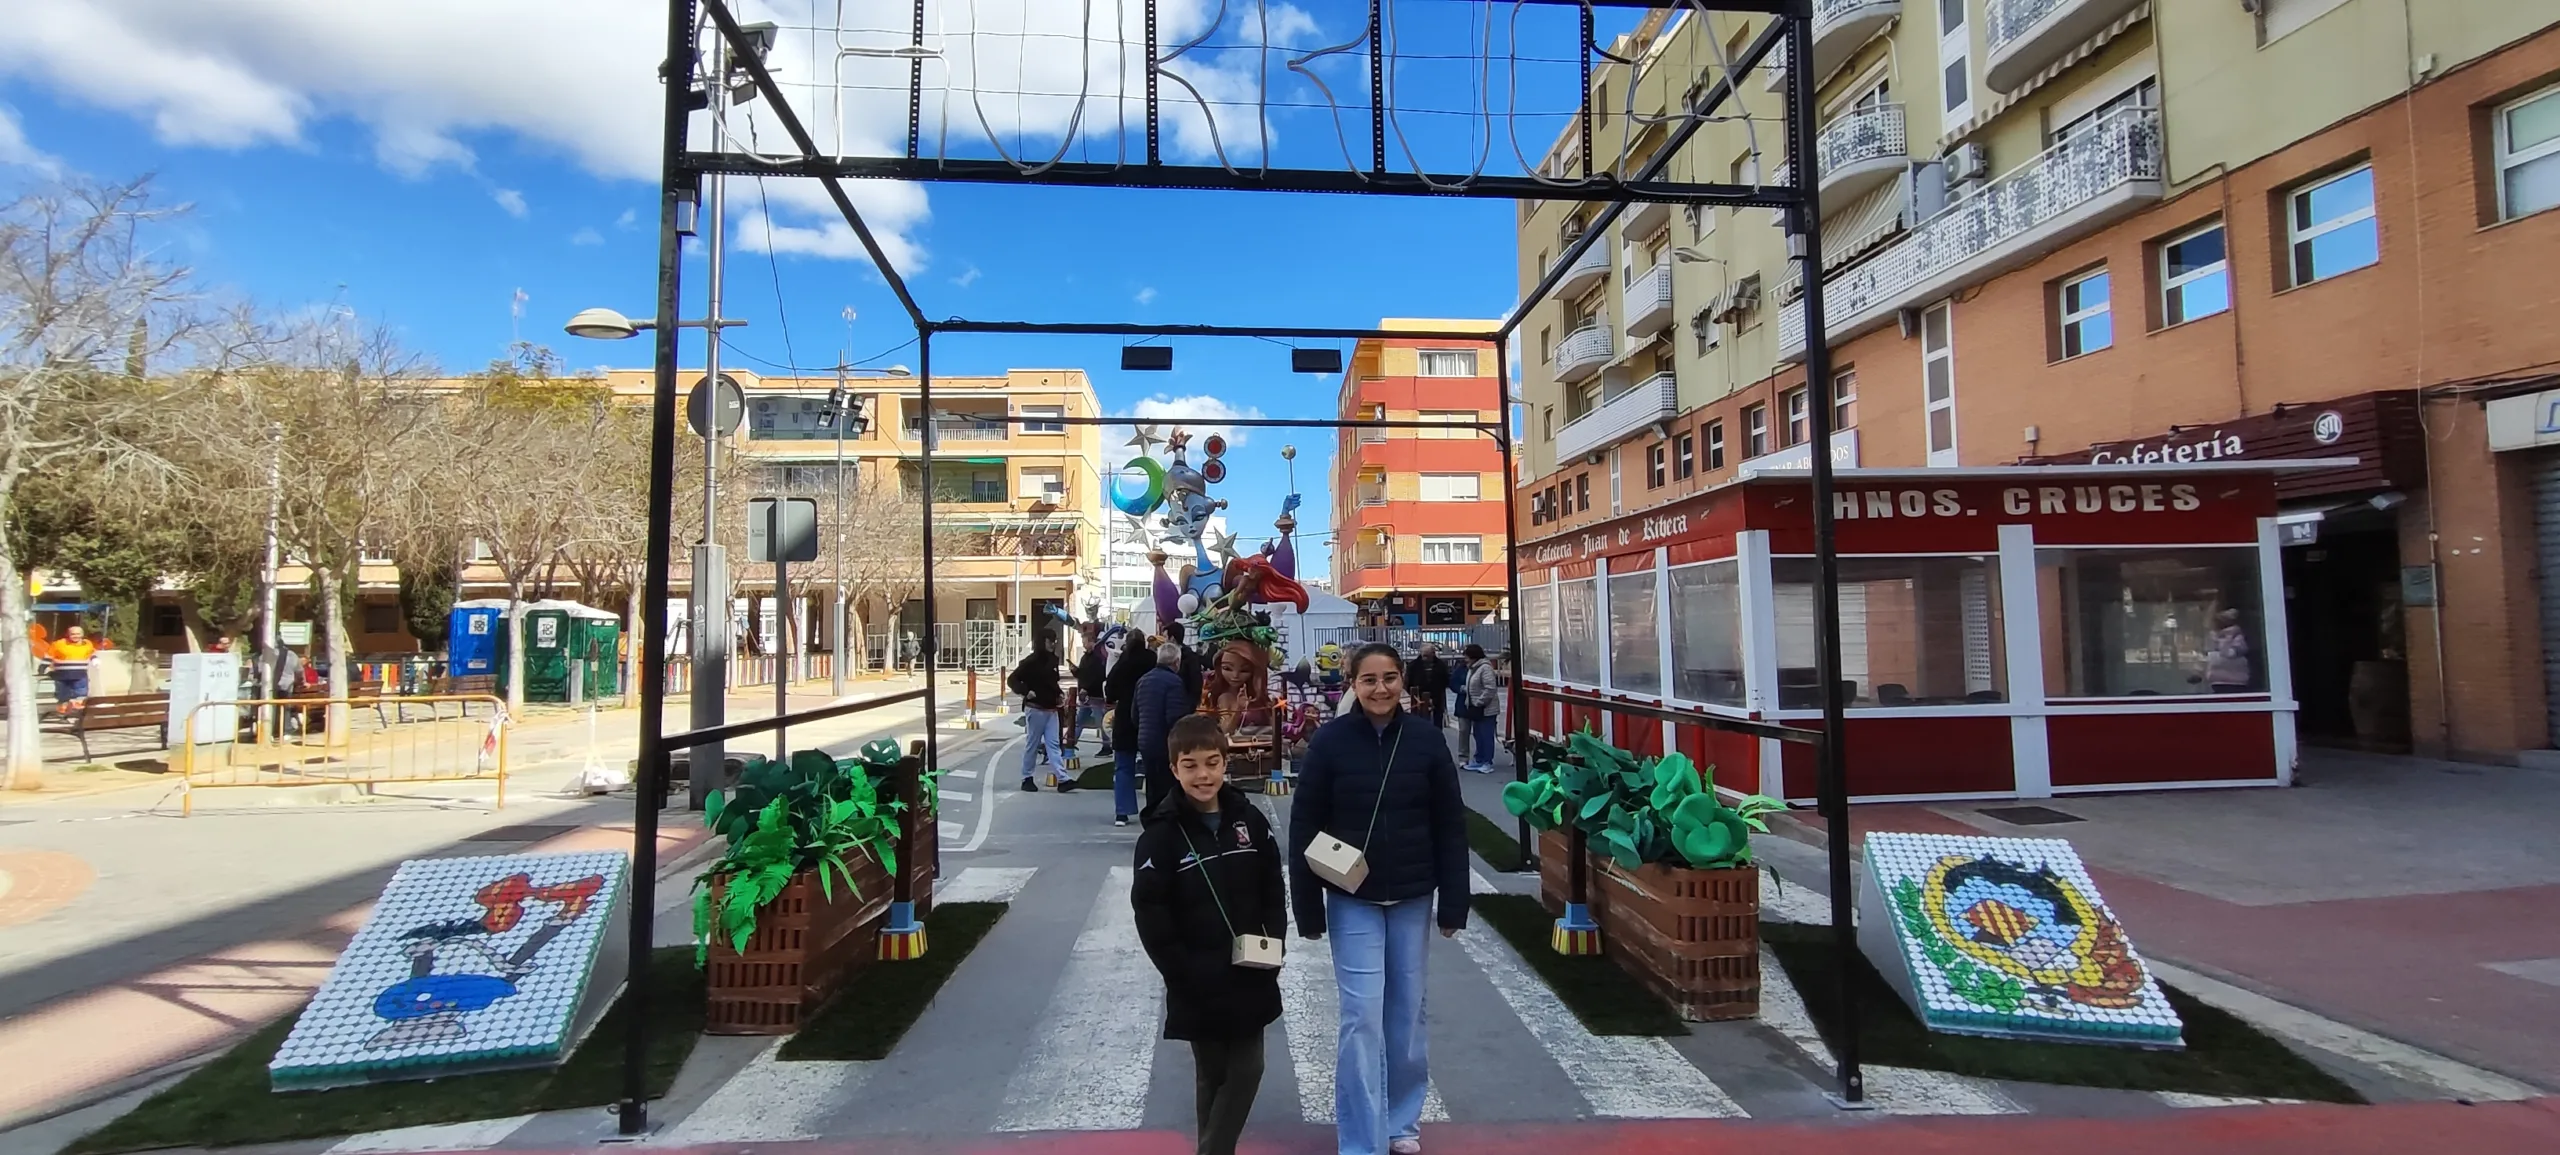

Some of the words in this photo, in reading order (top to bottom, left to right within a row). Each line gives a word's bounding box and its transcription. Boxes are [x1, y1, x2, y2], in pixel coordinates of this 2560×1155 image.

[1832, 489, 1978, 520] HNOS.
[2003, 484, 2201, 516] CRUCES
[1580, 533, 1609, 559] Juan
[1618, 527, 1631, 547] de
[1642, 514, 1688, 542] Ribera
